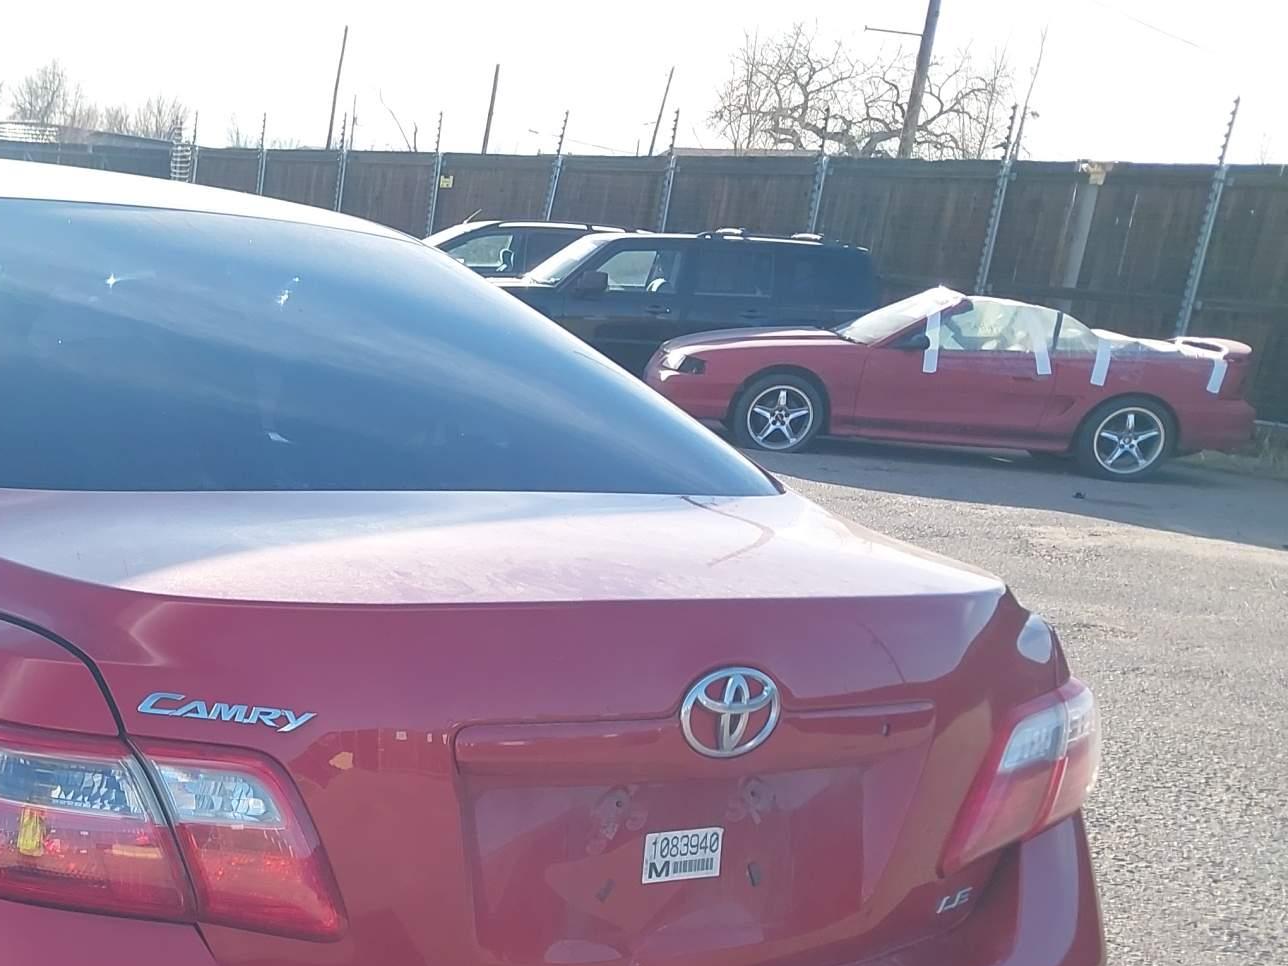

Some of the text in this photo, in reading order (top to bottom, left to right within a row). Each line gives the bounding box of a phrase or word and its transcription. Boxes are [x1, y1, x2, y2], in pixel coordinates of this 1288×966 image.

[137, 692, 318, 733] CAMRY
[652, 832, 720, 860] 1083940
[648, 860, 670, 879] M
[936, 886, 974, 914] LE
